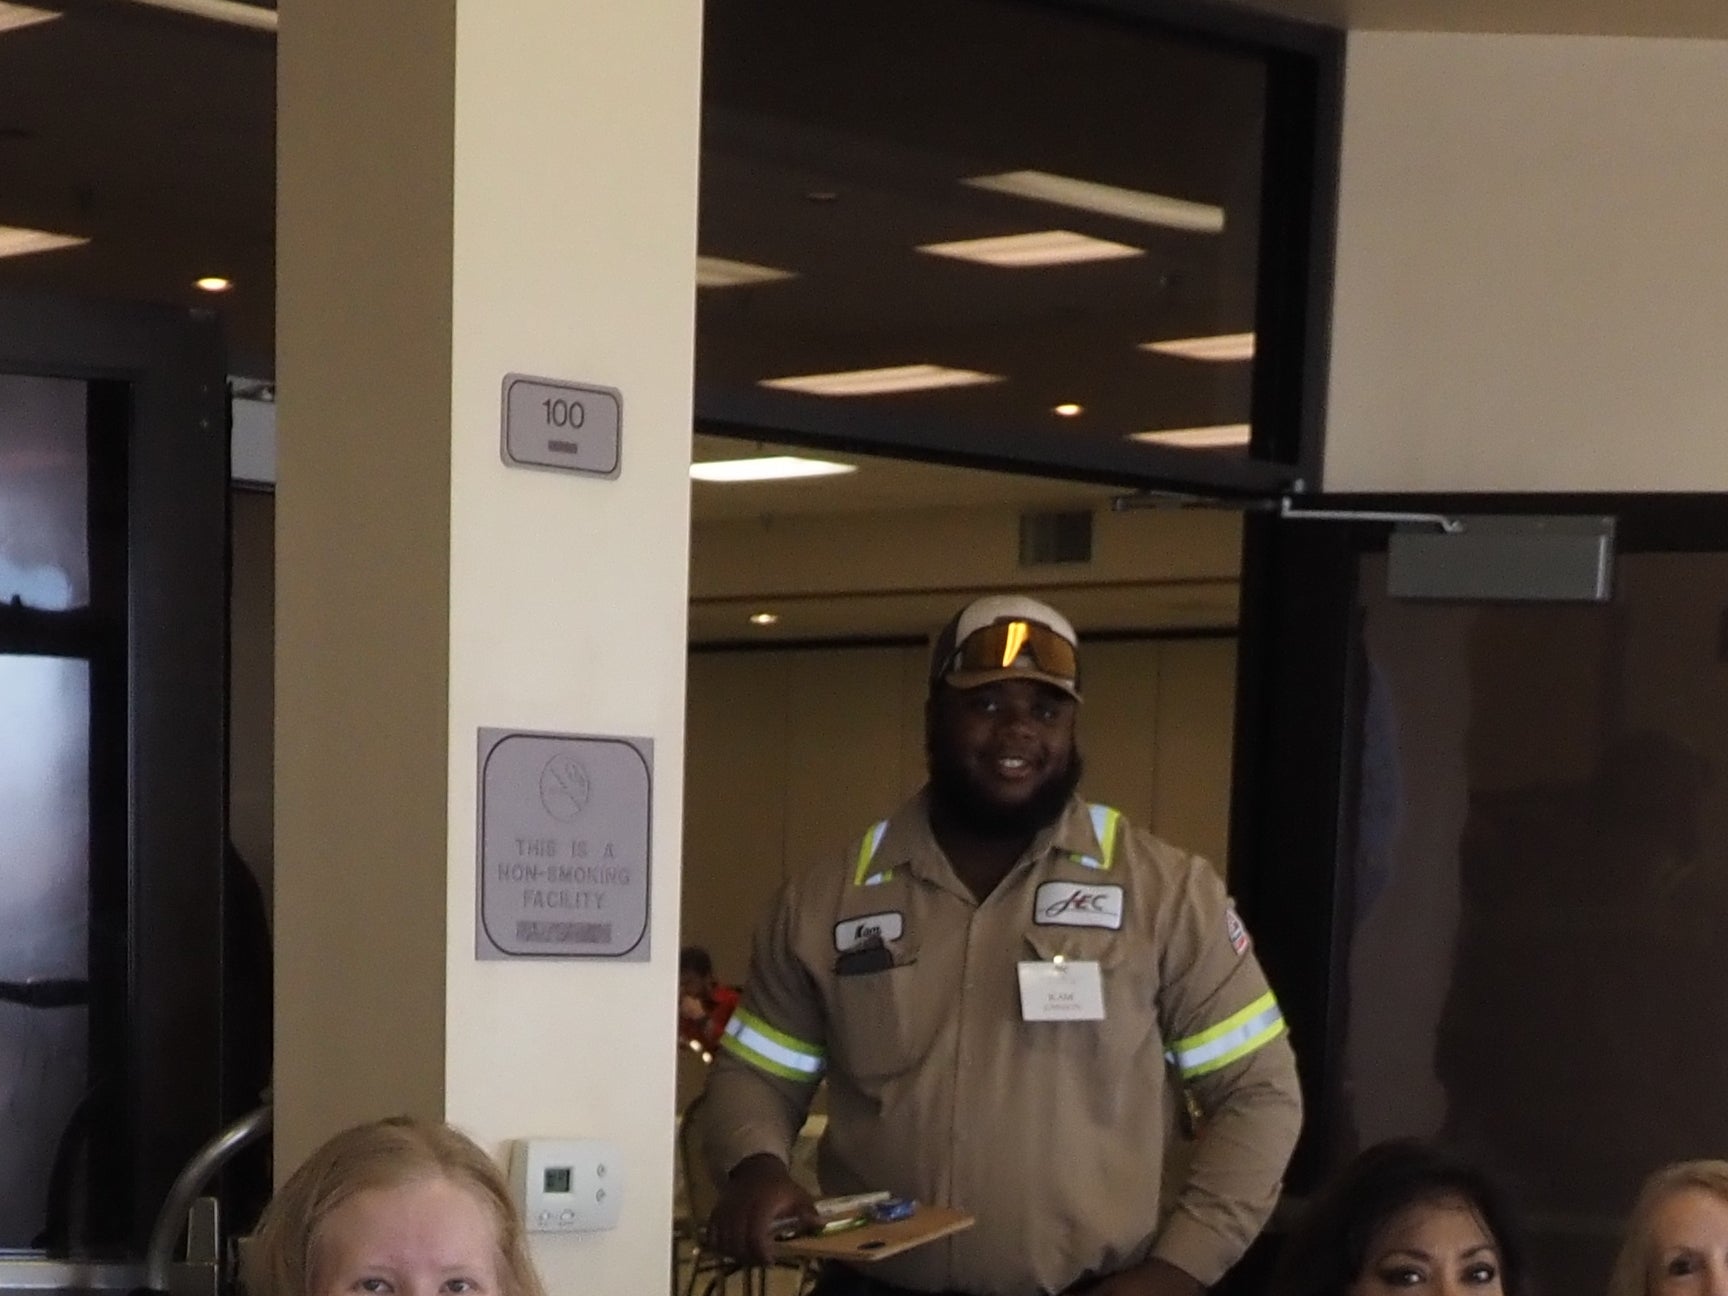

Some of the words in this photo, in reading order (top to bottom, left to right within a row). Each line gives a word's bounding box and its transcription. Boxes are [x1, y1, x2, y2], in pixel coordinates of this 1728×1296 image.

[542, 398, 584, 429] 100
[515, 838, 555, 858] THIS
[572, 840, 588, 858] IS
[603, 843, 614, 858] A
[497, 863, 630, 885] NON-SMOKING
[523, 889, 606, 909] FACILITY
[1045, 889, 1111, 918] JEC
